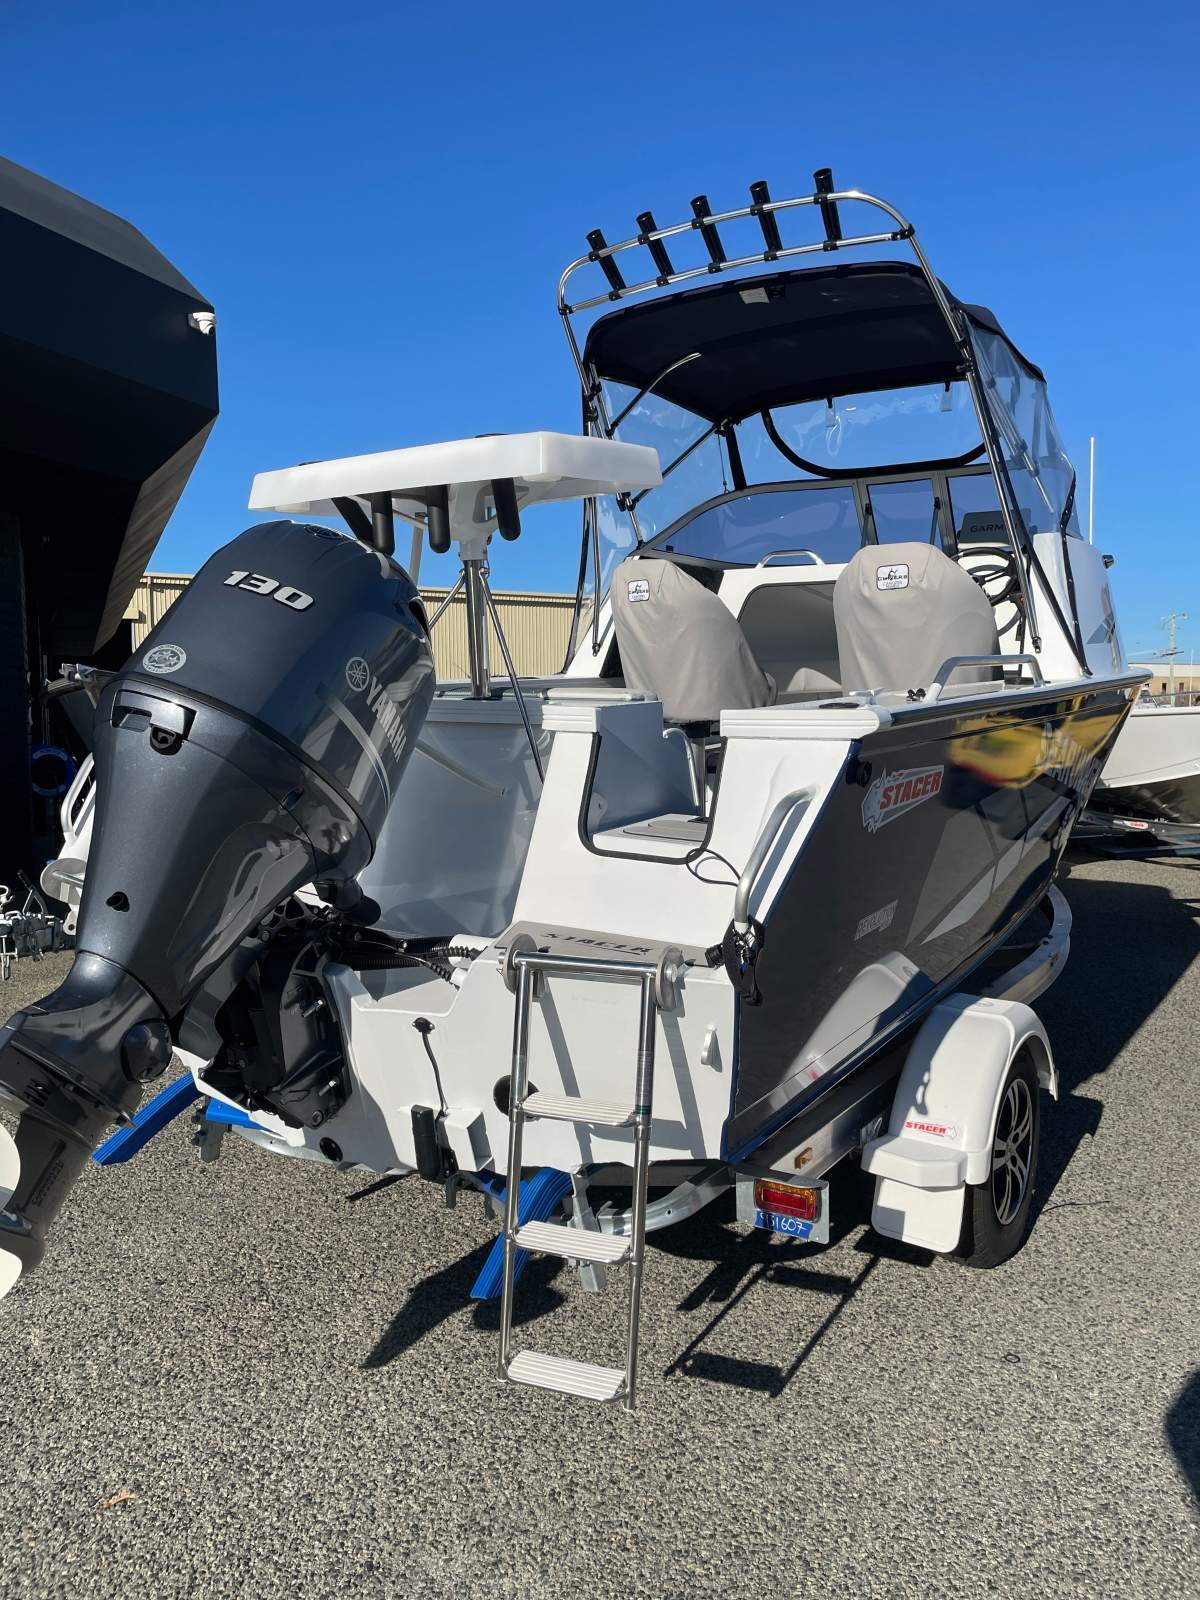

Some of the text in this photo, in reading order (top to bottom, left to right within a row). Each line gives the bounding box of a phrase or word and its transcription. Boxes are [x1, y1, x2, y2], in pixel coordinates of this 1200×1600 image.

[223, 570, 314, 610] 130
[366, 676, 407, 763] YAMAHA
[880, 771, 942, 810] STACER
[905, 1121, 946, 1134] STACER
